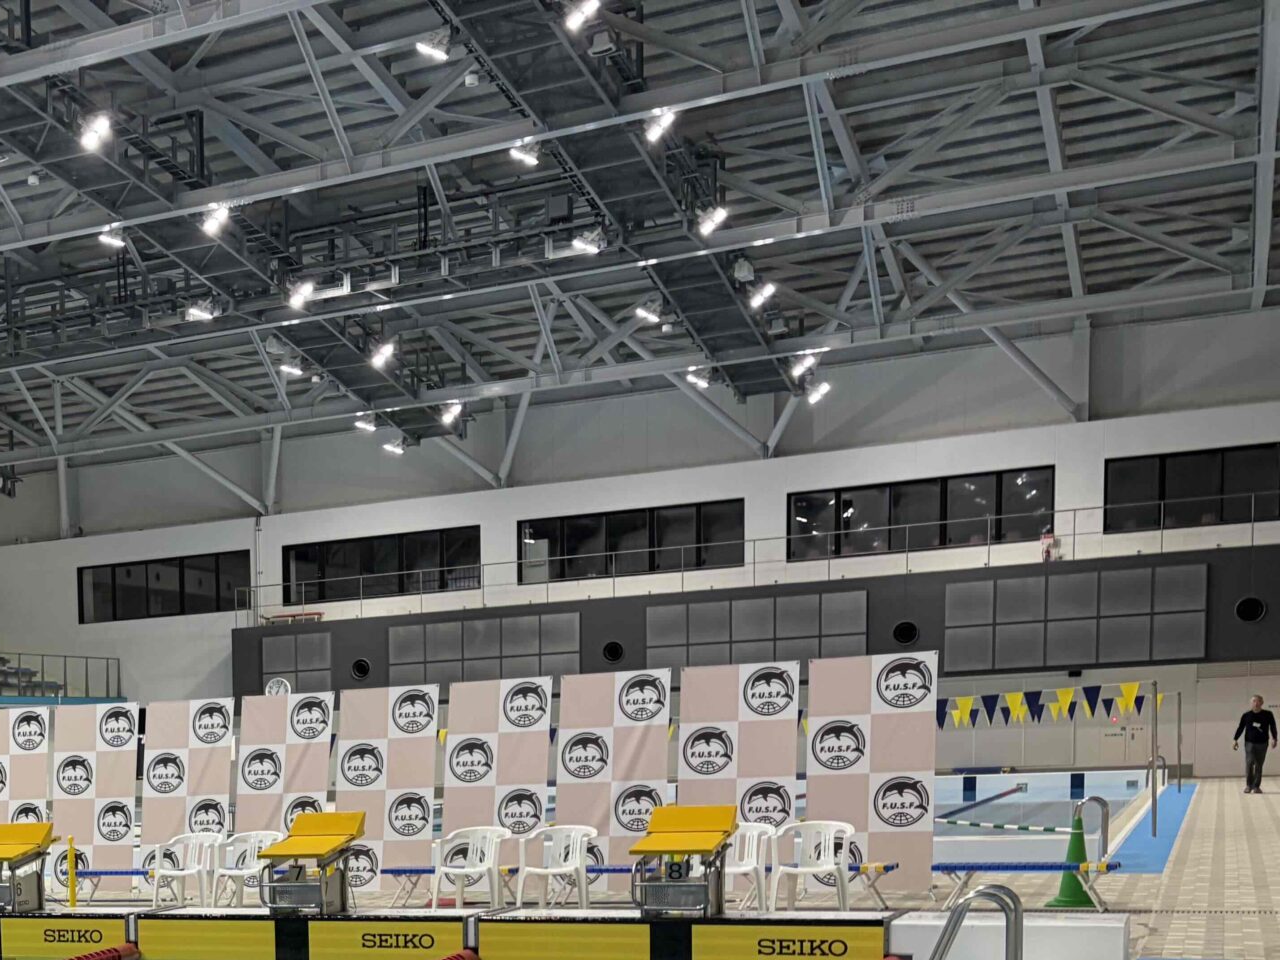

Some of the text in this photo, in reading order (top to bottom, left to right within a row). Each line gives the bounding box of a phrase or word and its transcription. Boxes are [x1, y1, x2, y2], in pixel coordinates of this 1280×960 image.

[885, 682, 917, 691] F.U.S.F
[751, 691, 780, 700] F.U.S.F
[626, 698, 654, 706] F.U.S.F
[510, 704, 536, 712] F.U.S.F
[398, 711, 424, 719] F.U.S.F
[820, 745, 851, 754] F.U.S.F
[691, 751, 720, 759] F.U.S.F
[456, 760, 482, 768] F.U.S.F
[748, 806, 777, 814] F.U.S.F
[882, 802, 913, 810] F.U.S.F
[292, 866, 302, 880] 7
[668, 863, 682, 879] 8
[44, 930, 102, 943] SEIKO
[362, 934, 434, 949] SEIKO
[757, 940, 848, 956] SEIKO
